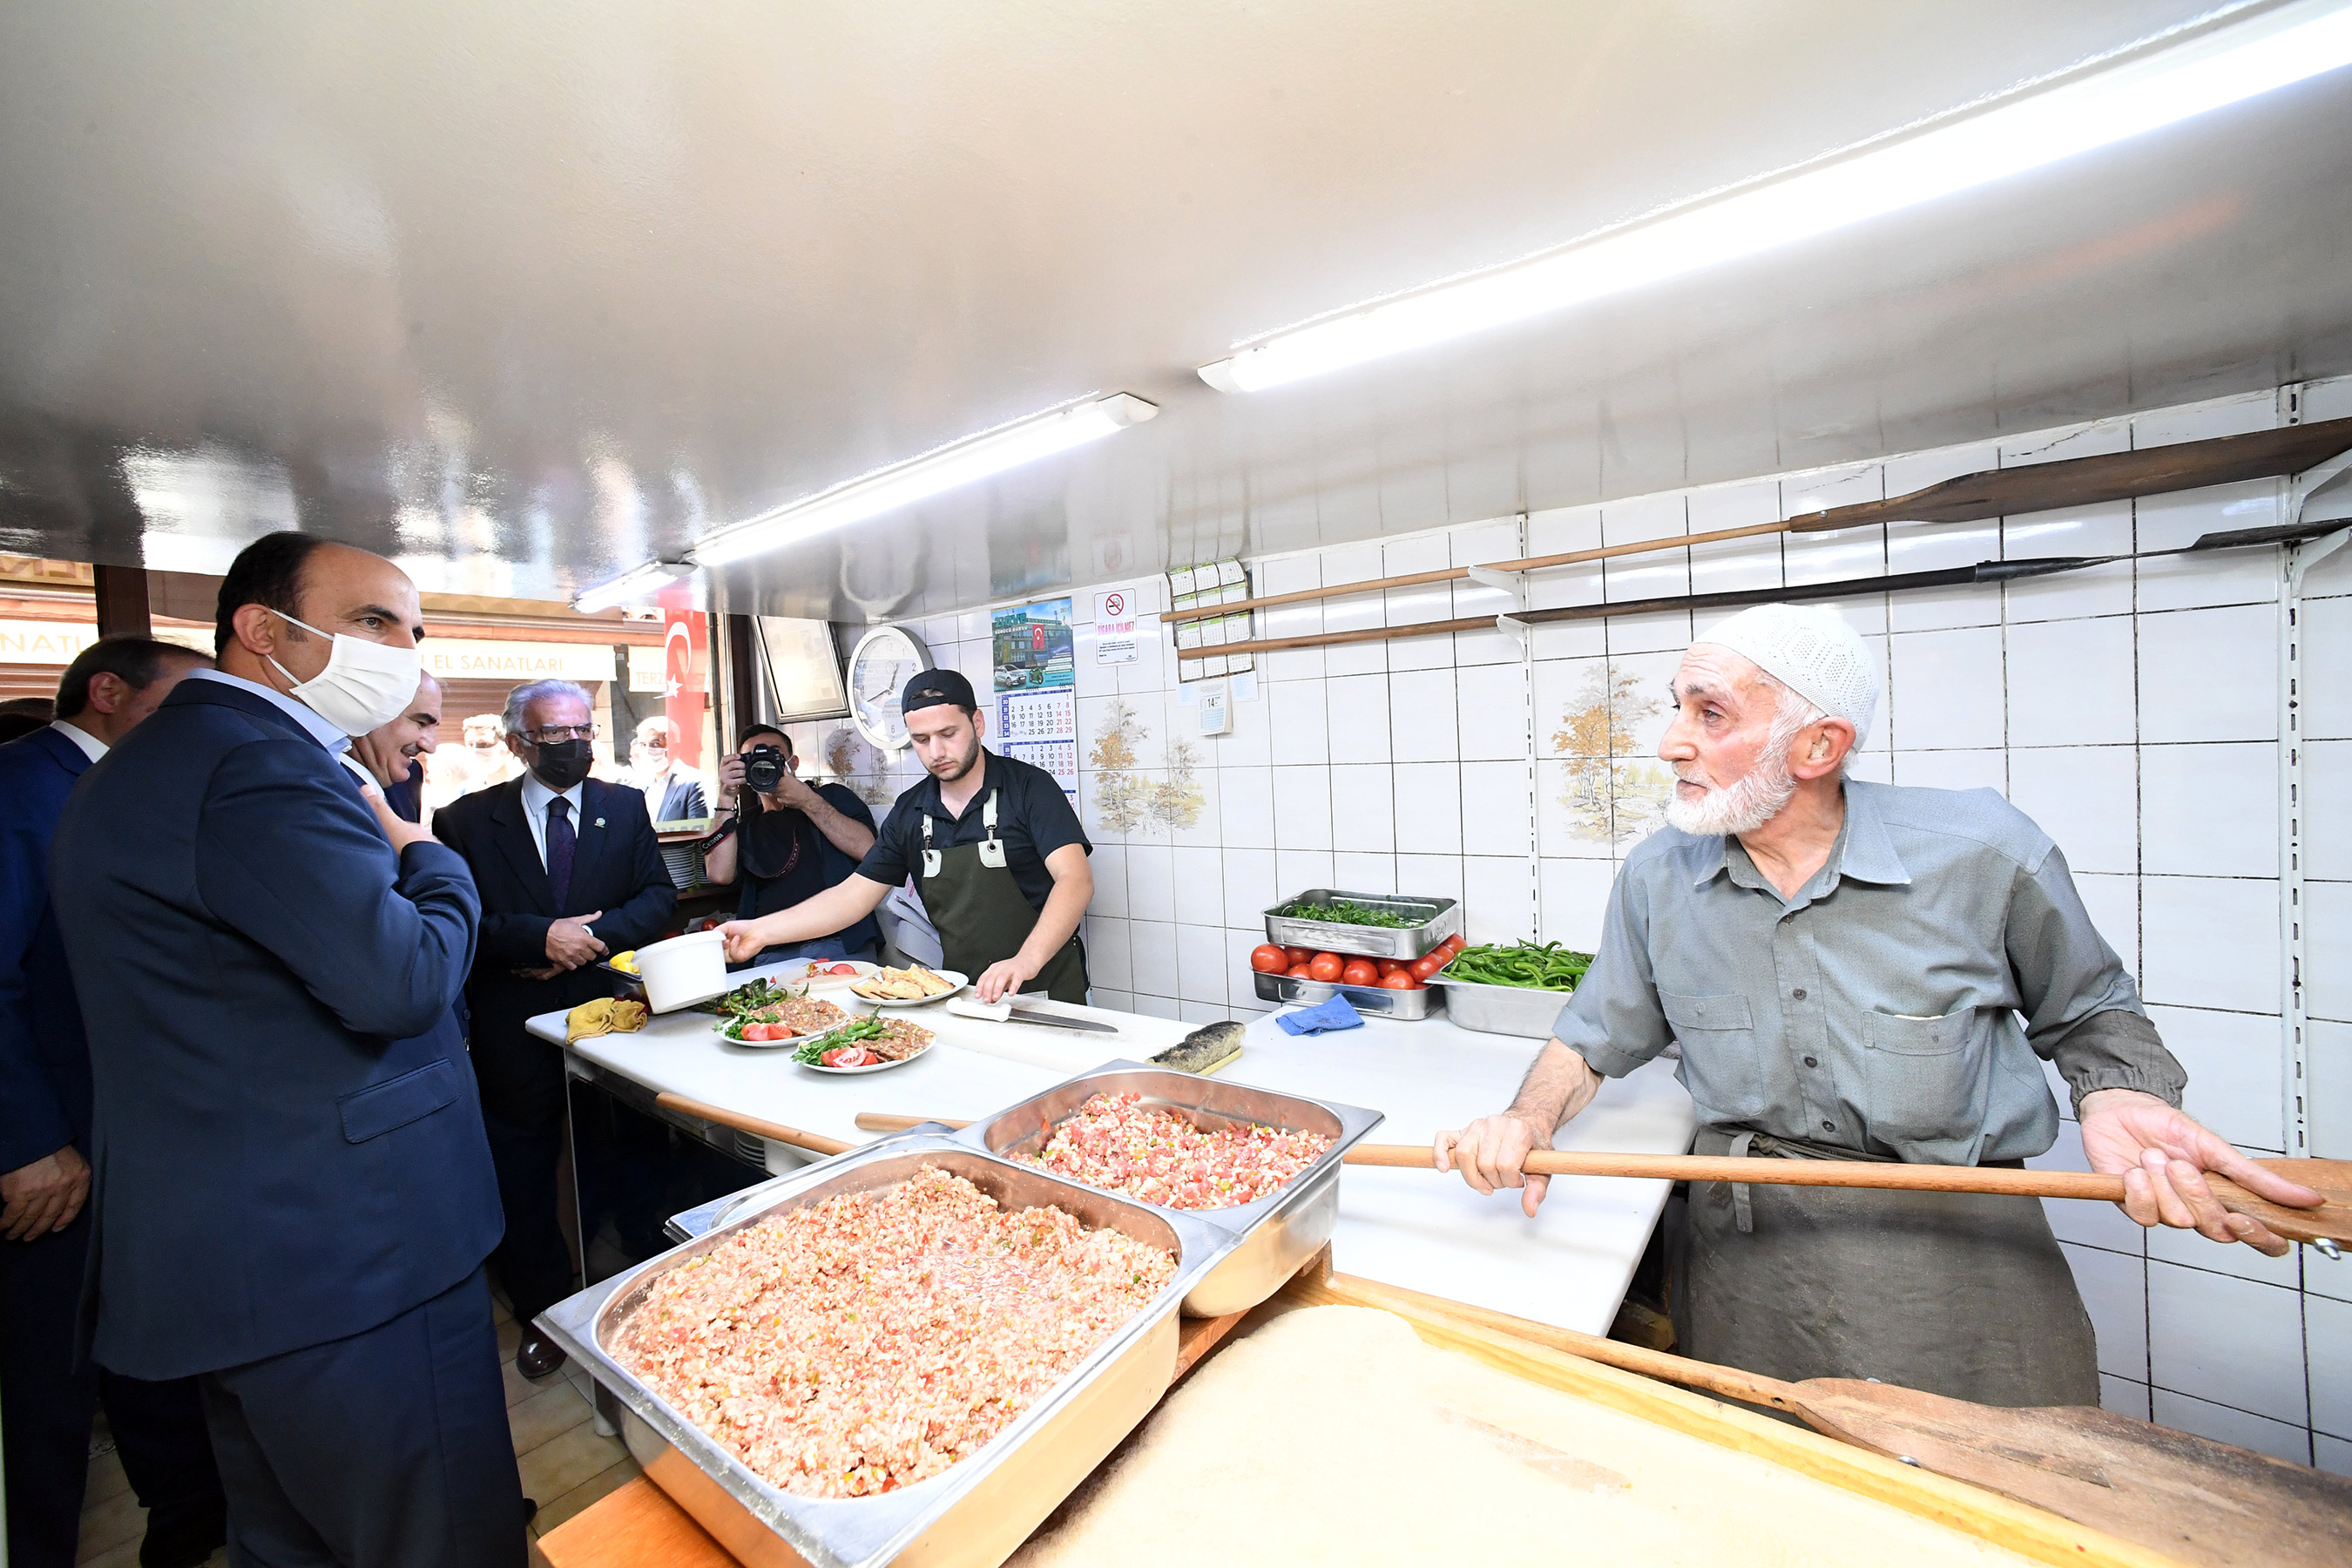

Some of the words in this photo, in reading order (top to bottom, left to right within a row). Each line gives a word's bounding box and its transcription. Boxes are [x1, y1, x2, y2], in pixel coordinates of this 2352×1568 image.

[434, 654, 453, 669] EL
[461, 655, 563, 672] SANATLARI
[912, 663, 916, 672] 2
[1207, 697, 1214, 708] 14
[890, 725, 895, 733] 6
[701, 832, 724, 849] Canon
